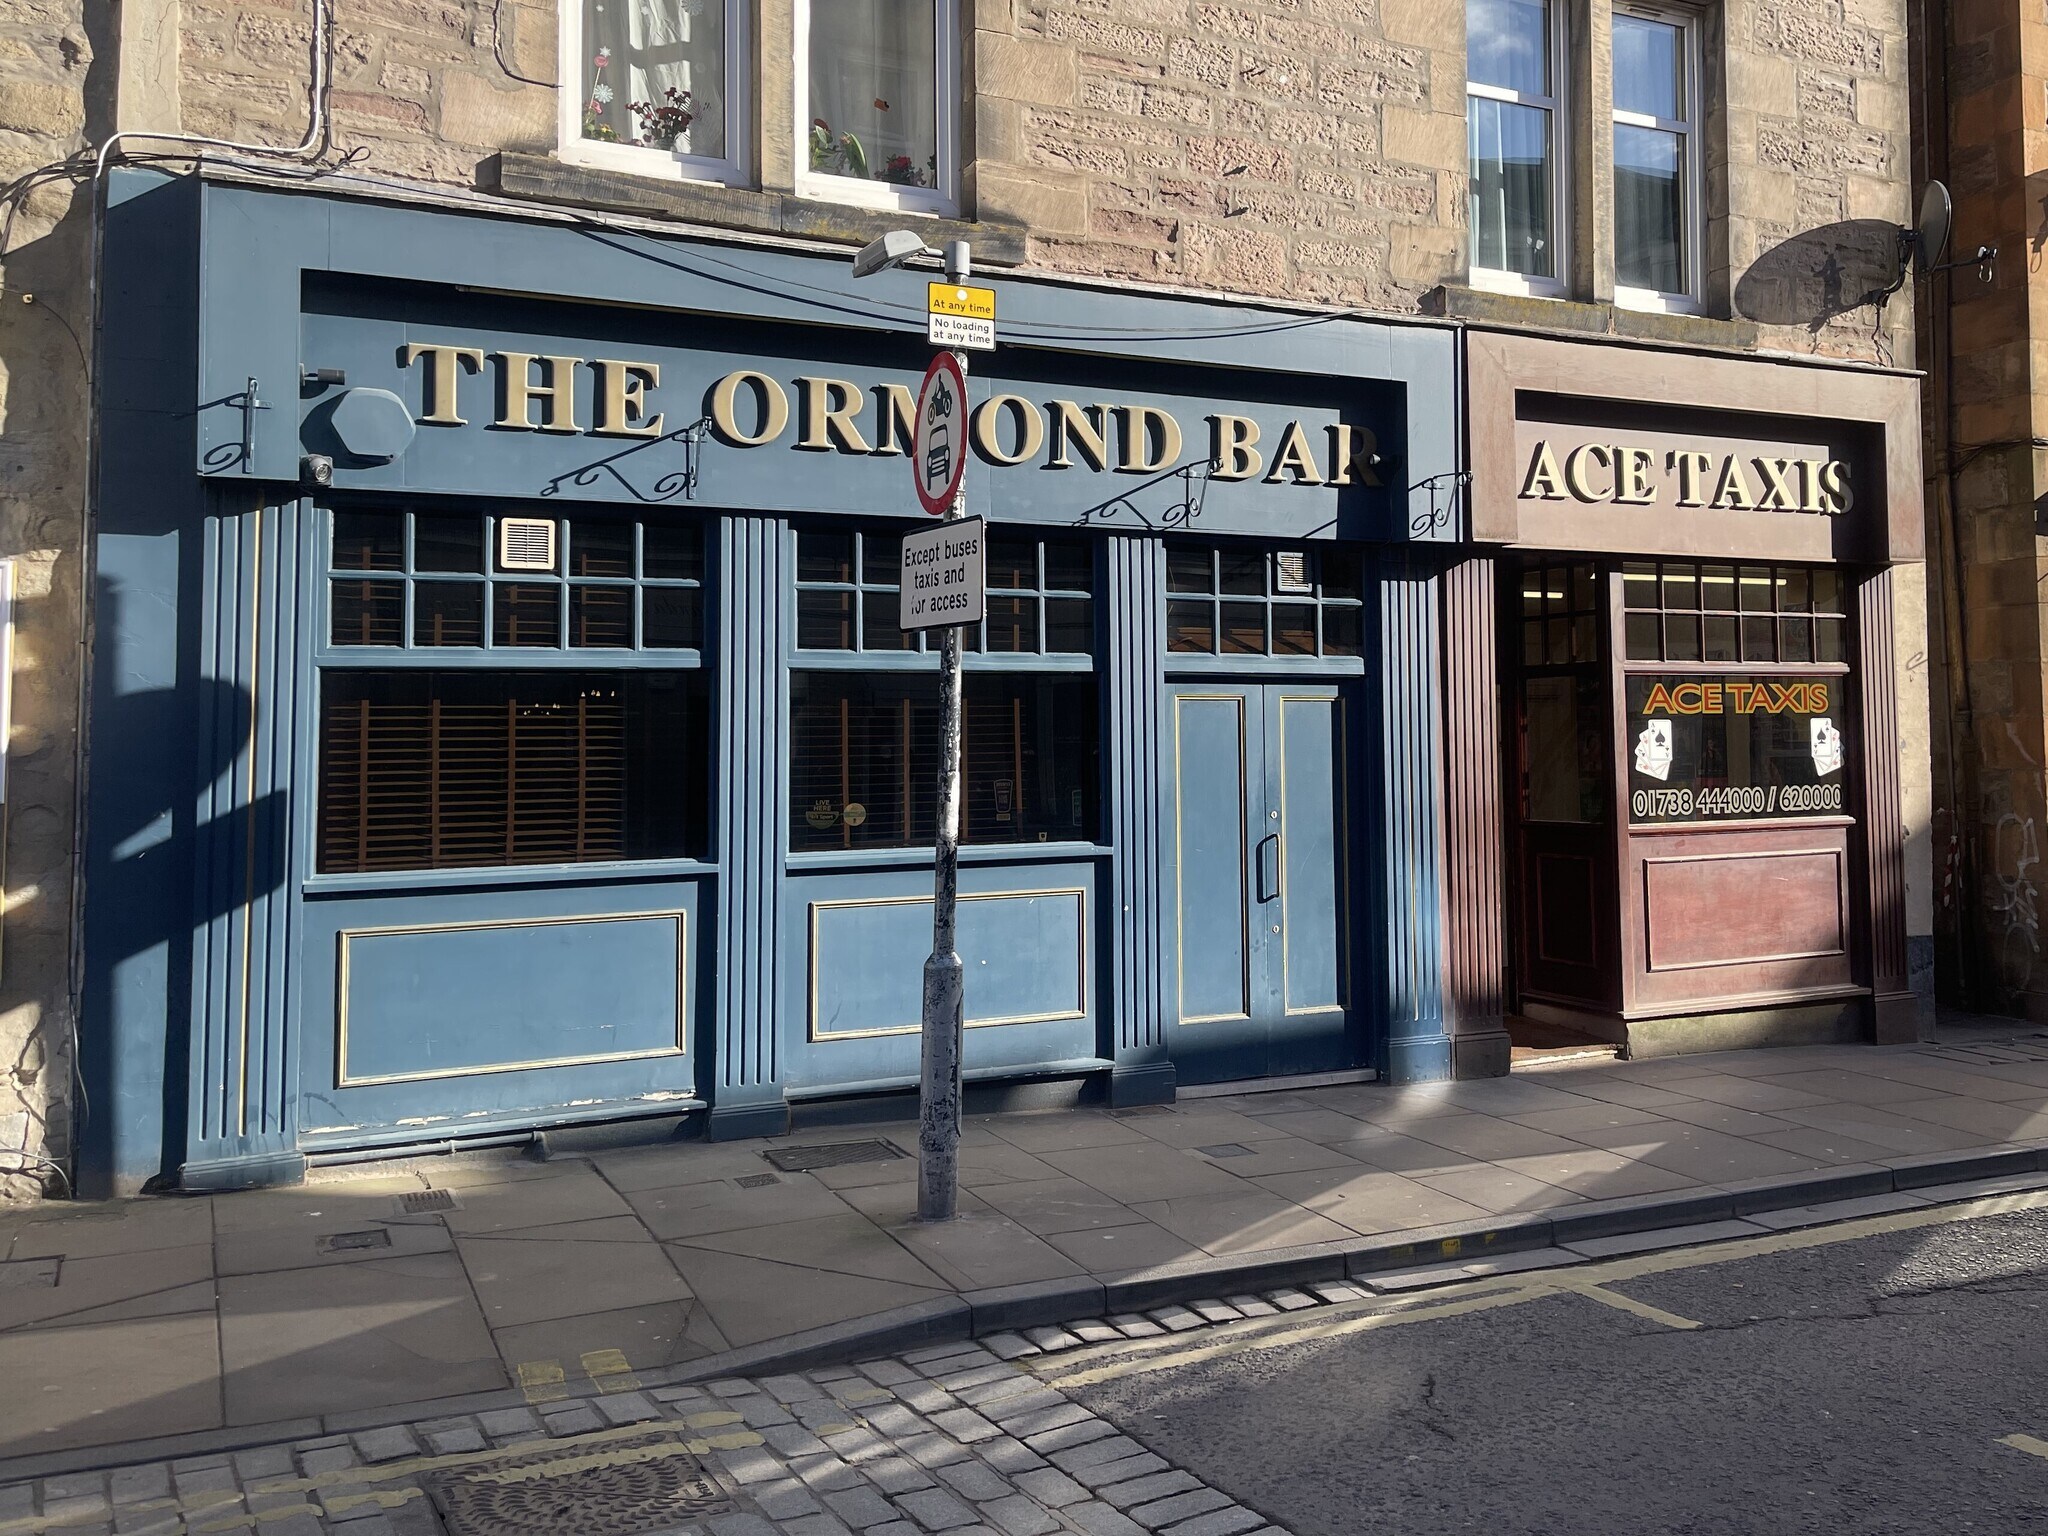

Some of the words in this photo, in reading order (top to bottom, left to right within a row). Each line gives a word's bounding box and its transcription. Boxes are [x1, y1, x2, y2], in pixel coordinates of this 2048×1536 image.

[934, 299, 945, 309] At
[948, 302, 966, 312] any
[969, 303, 991, 314] time
[933, 330, 944, 339] at
[947, 332, 965, 342] any
[968, 333, 991, 344] time
[935, 318, 949, 328] No
[952, 319, 989, 334] loading
[406, 341, 664, 438] THE
[1207, 414, 1385, 487] BAR
[1524, 439, 1659, 503] ACE
[1672, 450, 1852, 514] TAXIS
[905, 541, 940, 567] Except
[944, 539, 978, 560] buses
[914, 567, 940, 590] taxis
[944, 562, 965, 585] and
[930, 592, 968, 612] access
[1642, 682, 1724, 715] ACE
[1725, 683, 1829, 714] TAXIS
[1632, 788, 1694, 817] 01738
[1696, 786, 1765, 815] 444000
[1767, 785, 1778, 813] /
[1779, 784, 1842, 812] 620000
